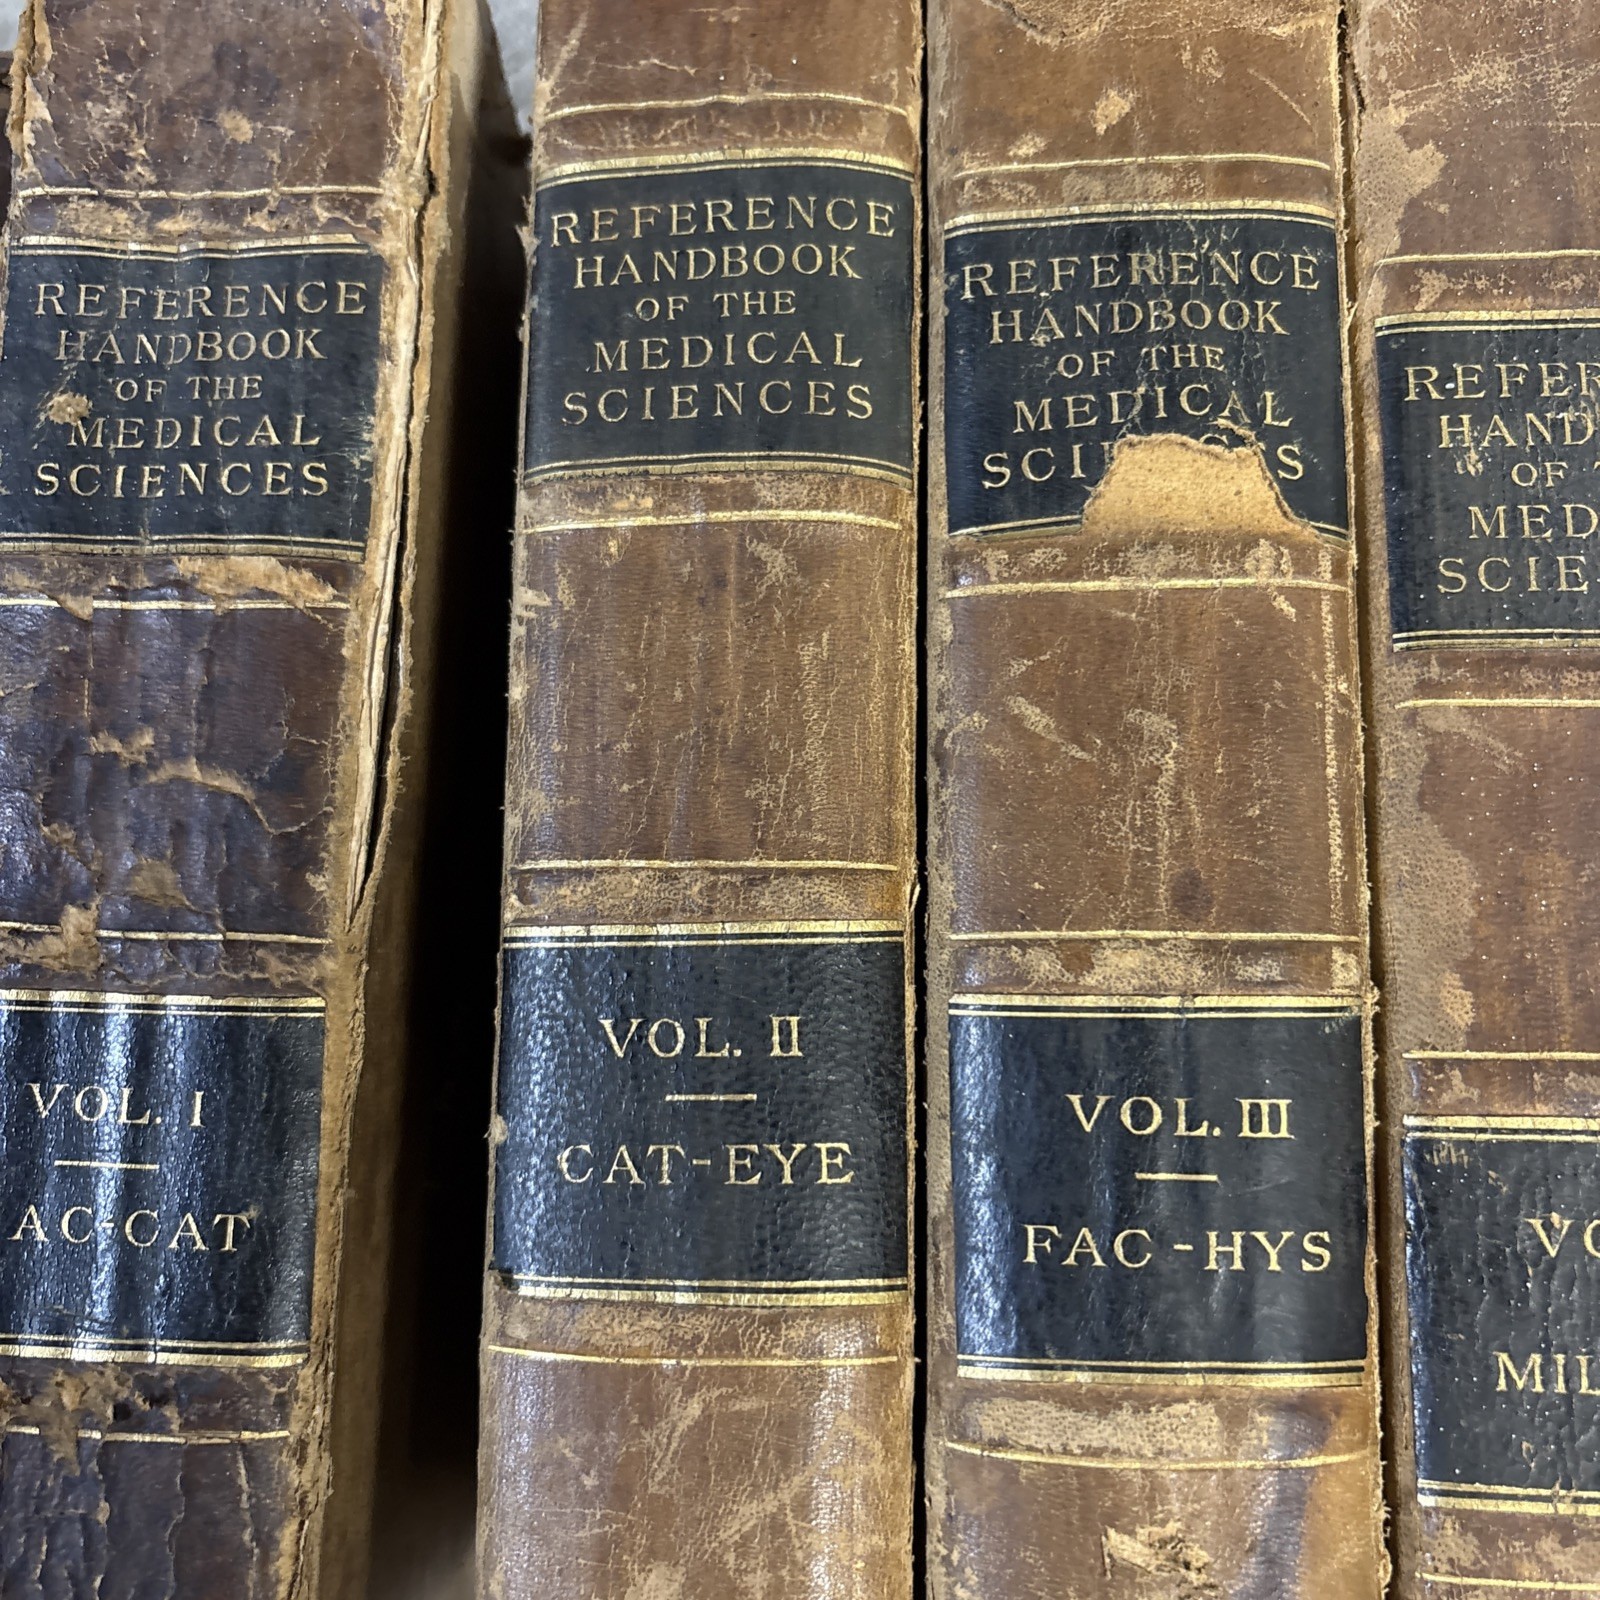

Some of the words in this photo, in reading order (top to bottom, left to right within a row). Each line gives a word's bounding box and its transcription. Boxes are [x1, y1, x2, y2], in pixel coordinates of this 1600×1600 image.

[550, 196, 896, 248] REFERENCE
[572, 242, 863, 290] HANDBOOK
[960, 251, 1321, 301] REFERENCE
[34, 281, 367, 321] REFERENCE
[635, 295, 690, 322] OF
[713, 290, 797, 318] THE
[988, 299, 1291, 345] HANDBOOK
[55, 328, 328, 366] HANDBOOK
[592, 330, 864, 374] MEDICAL
[1056, 350, 1116, 378] OF
[1141, 344, 1227, 371] THE
[115, 379, 168, 403] OF
[186, 375, 264, 401] THE
[562, 380, 875, 426] SCIENCES
[1012, 384, 1294, 434] MEDICAL
[66, 414, 321, 449] MEDICAL
[1438, 412, 1595, 449] HAND
[34, 462, 329, 499] SCIENCES
[1511, 461, 1569, 488] OF
[1468, 504, 1599, 540] MED
[1437, 556, 1589, 594] SCIE
[599, 1015, 743, 1059] VOL.
[769, 1014, 804, 1058] II
[27, 1082, 163, 1126] VOL.
[190, 1090, 206, 1128] I
[1066, 1094, 1221, 1138] VOL.
[1236, 1097, 1295, 1139] III
[556, 1142, 855, 1186] CAT-EYE
[8, 1203, 251, 1252] AC-CAT
